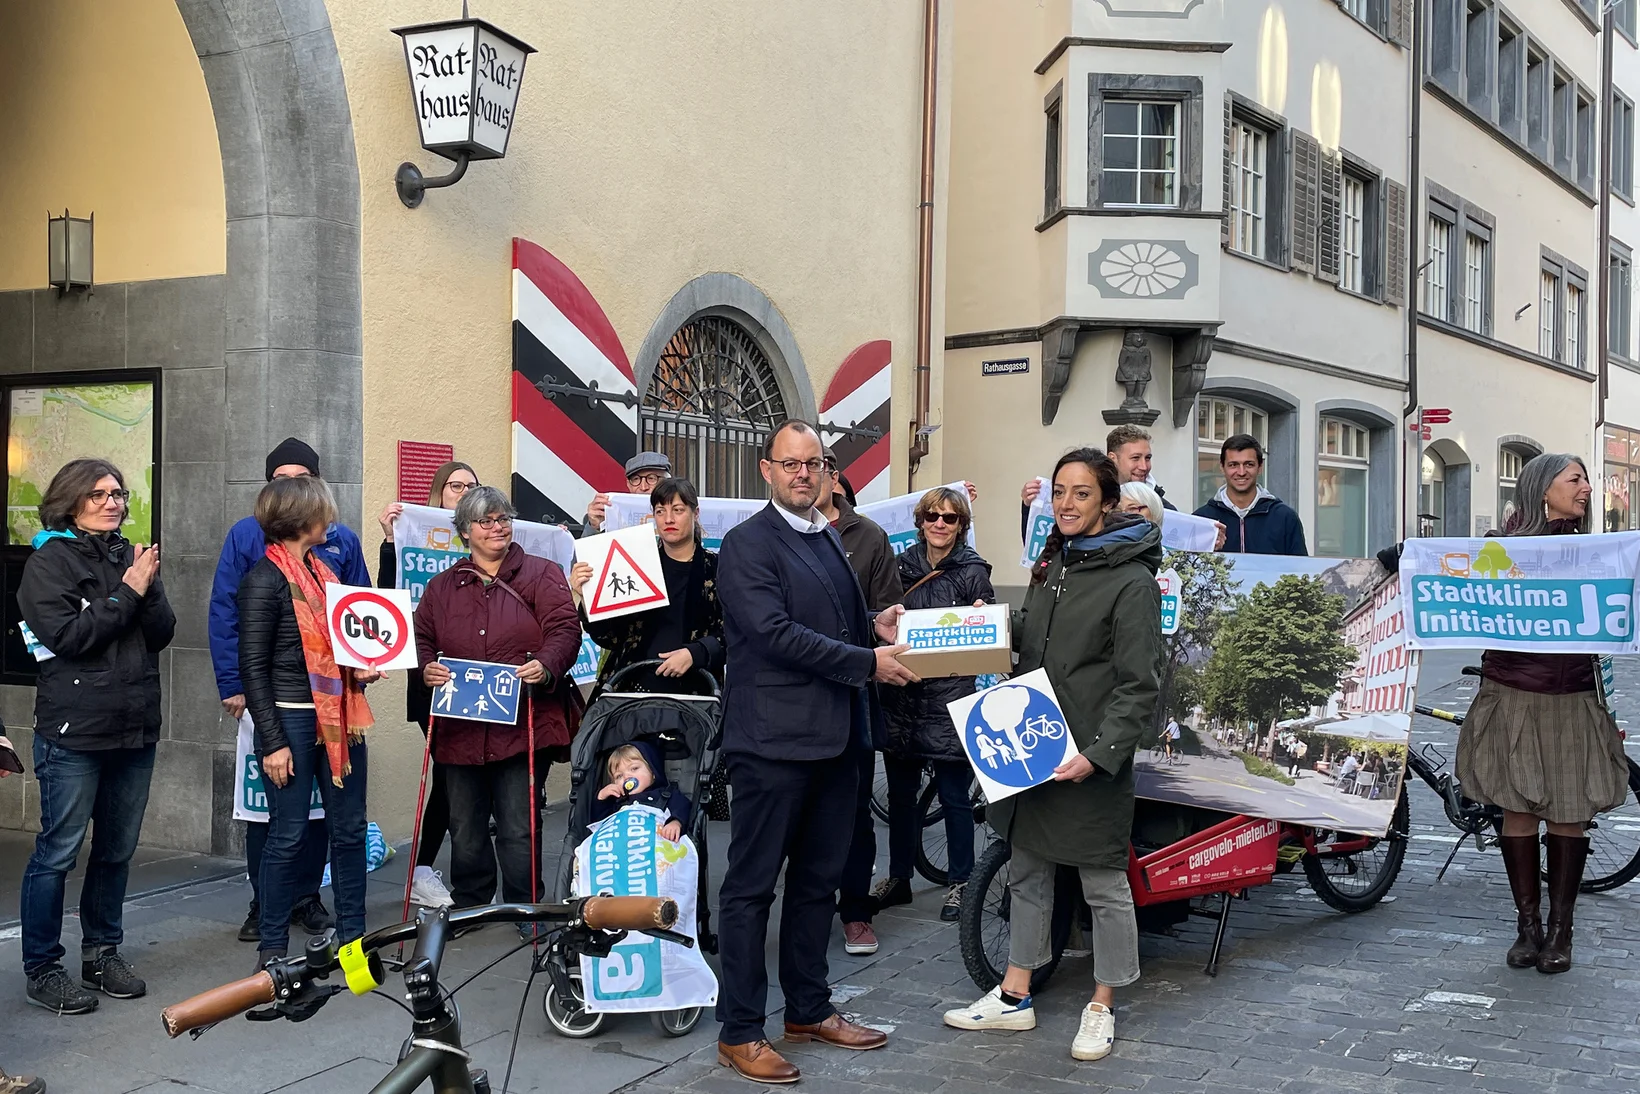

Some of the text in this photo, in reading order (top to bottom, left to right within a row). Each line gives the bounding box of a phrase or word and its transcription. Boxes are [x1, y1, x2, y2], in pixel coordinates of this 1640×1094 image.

[413, 42, 471, 80] Rat-
[478, 43, 517, 90] Rat-
[420, 84, 470, 128] haus
[475, 83, 510, 130] haus
[984, 362, 1027, 372] Rathausgasse
[1417, 581, 1632, 637] Stadtklima Ja
[1419, 608, 1571, 636] Initiativen
[910, 626, 995, 639] Stadtklima
[910, 635, 994, 648] Initiative
[1189, 820, 1277, 869] cargovelo-mieten.ch
